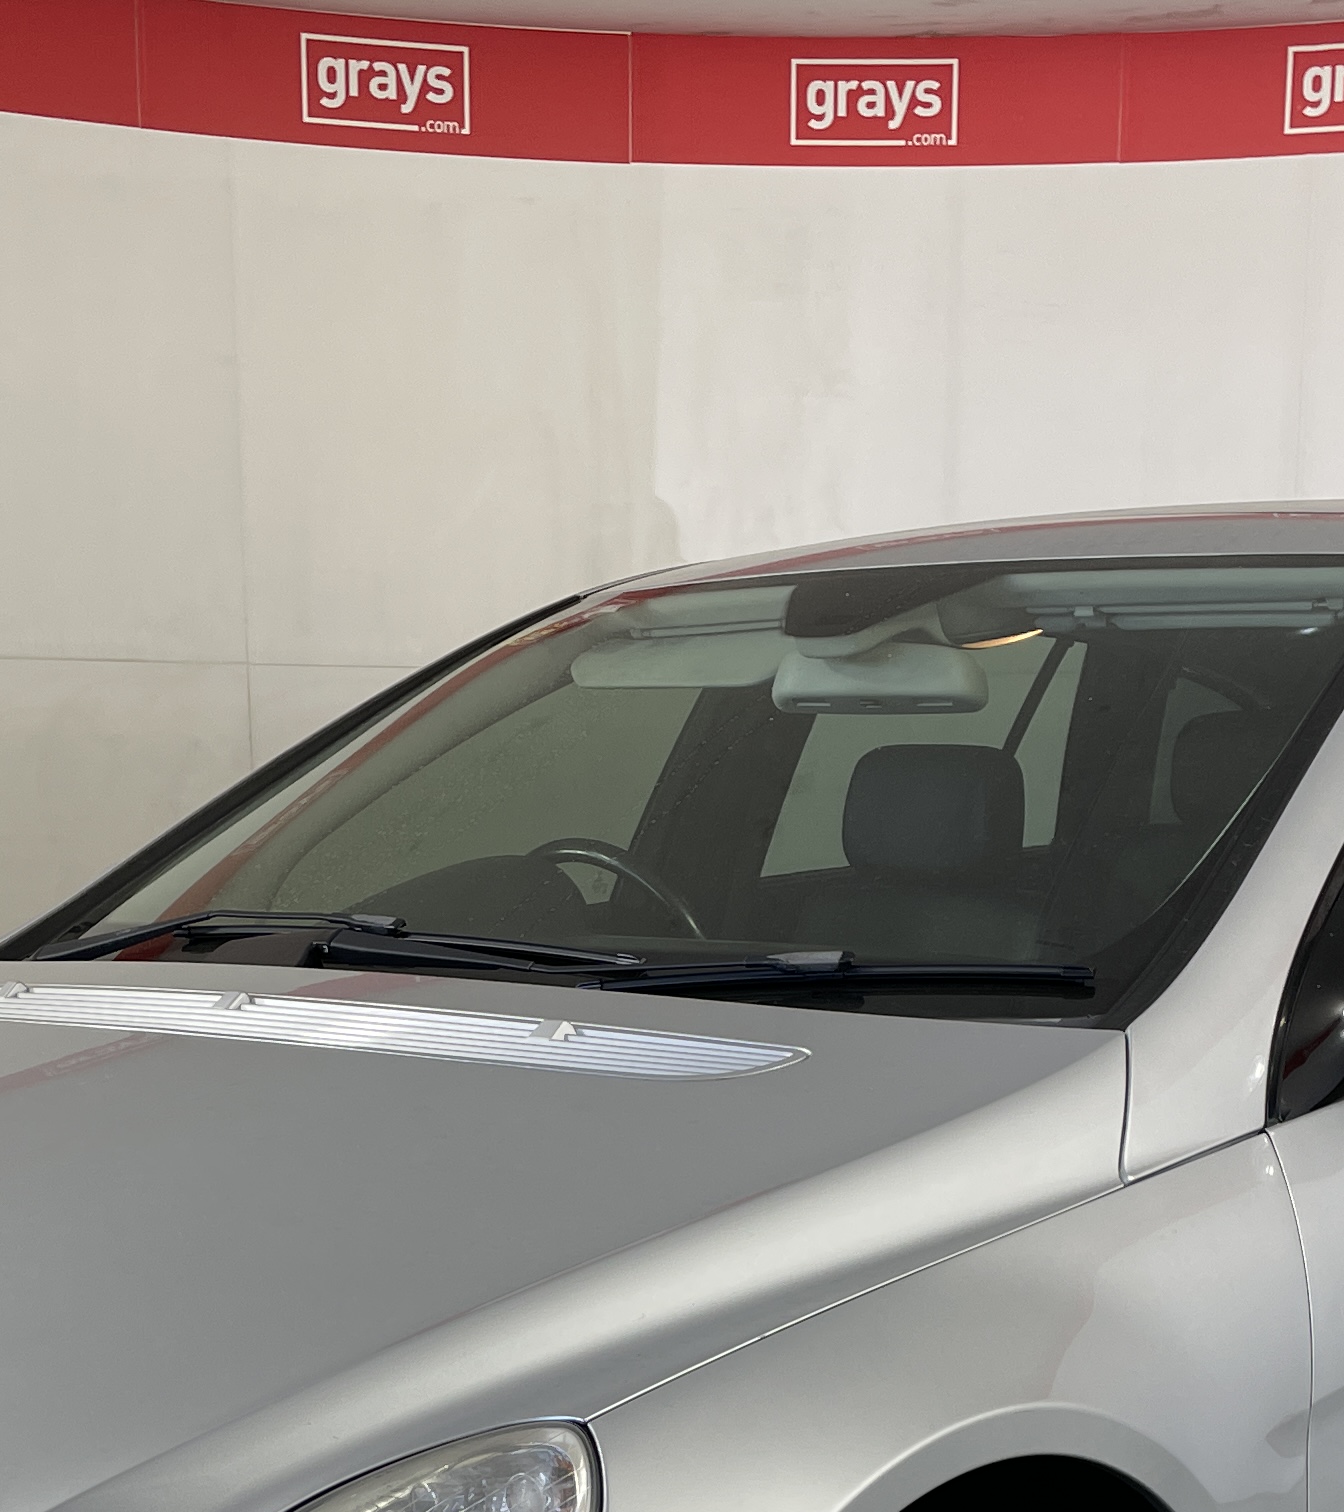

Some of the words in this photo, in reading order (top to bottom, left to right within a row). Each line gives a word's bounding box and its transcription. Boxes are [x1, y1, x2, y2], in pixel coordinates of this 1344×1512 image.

[317, 56, 454, 114] grays
[806, 79, 942, 130] grays
[420, 119, 460, 134] .com
[907, 133, 948, 146] .com
